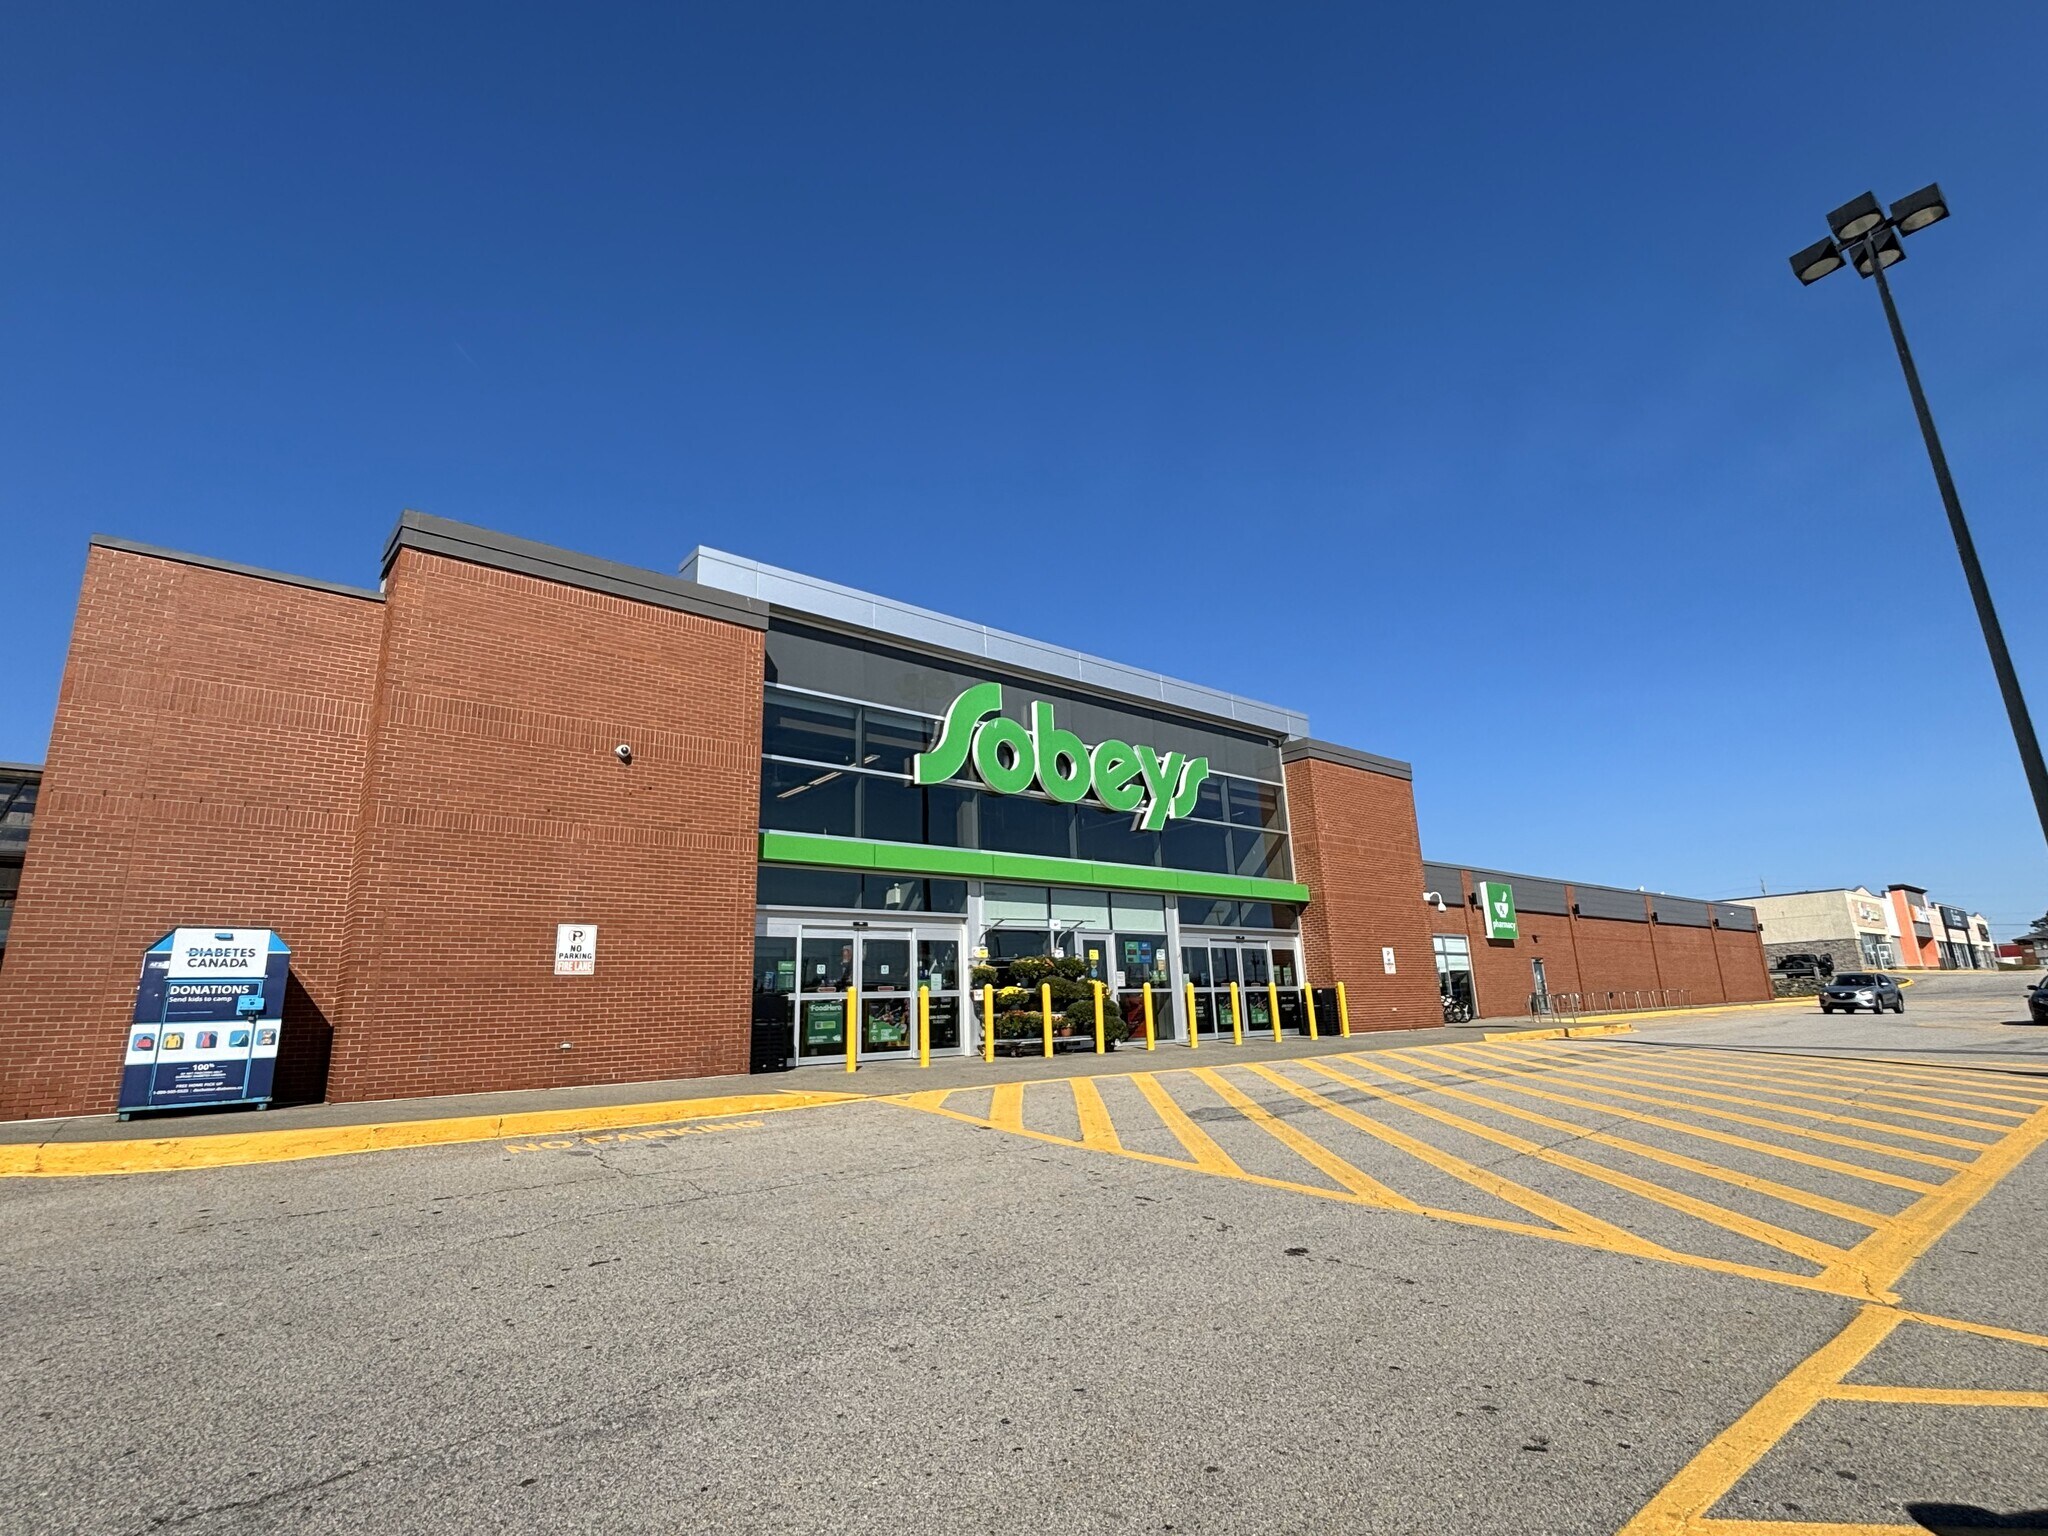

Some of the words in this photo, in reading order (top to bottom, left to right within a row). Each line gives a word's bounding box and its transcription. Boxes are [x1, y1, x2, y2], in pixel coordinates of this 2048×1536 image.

[914, 682, 1209, 831] Sobeys
[1493, 919, 1516, 932] pharmacy
[188, 947, 256, 958] DIABETES
[187, 958, 249, 968] CANADA
[558, 961, 573, 971] FIRE
[574, 961, 592, 971] LANE
[170, 985, 250, 995] DONATIONS
[810, 1004, 842, 1012] FoodHero
[504, 1139, 574, 1154] NO
[582, 1119, 765, 1146] PARKING
